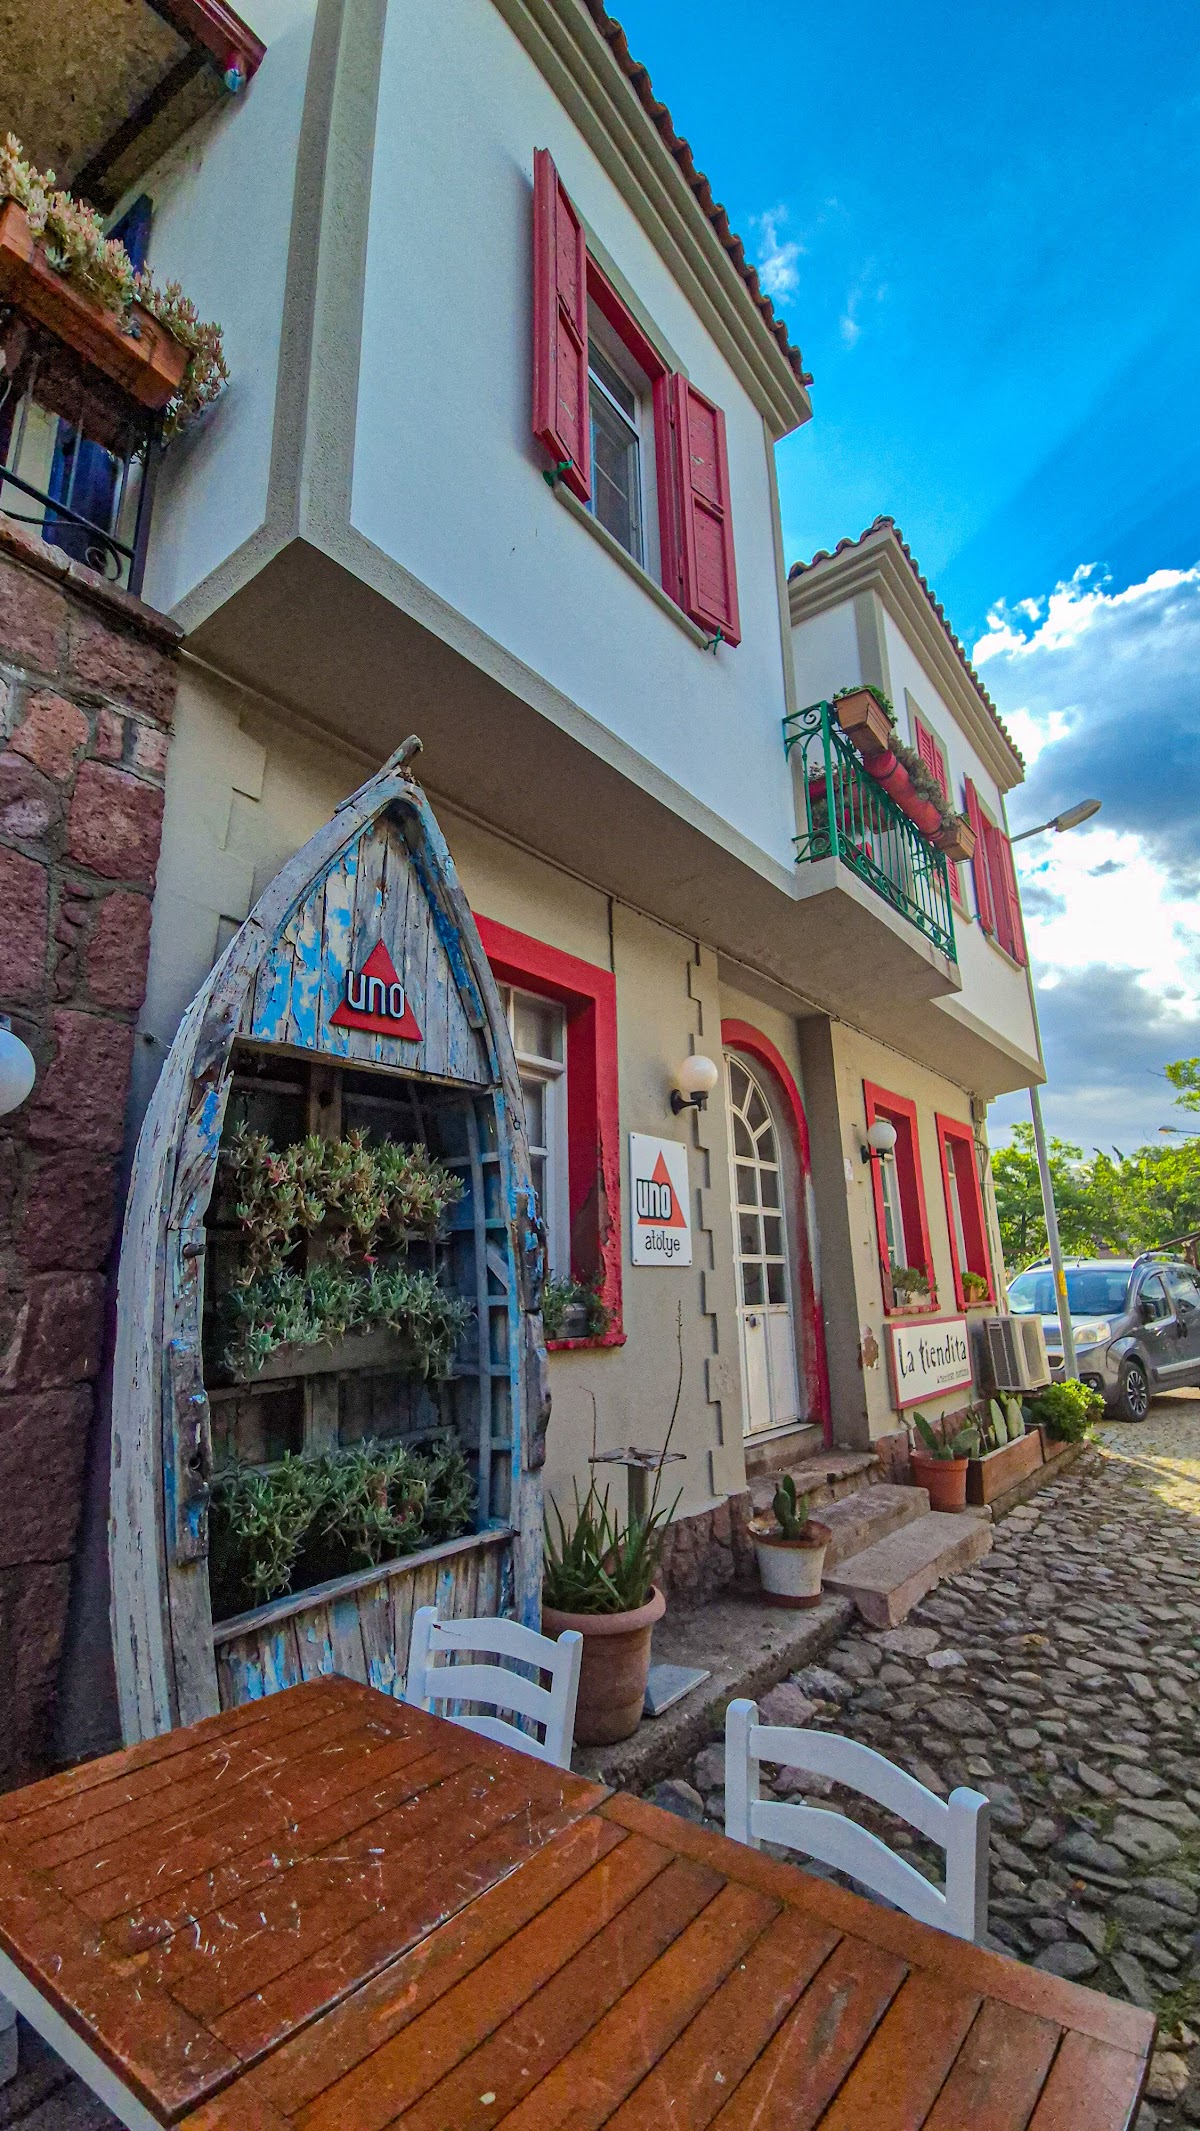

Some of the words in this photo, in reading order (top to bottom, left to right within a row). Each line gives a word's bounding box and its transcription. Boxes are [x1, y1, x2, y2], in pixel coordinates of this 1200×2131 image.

[345, 969, 405, 1019] uno
[636, 1178, 672, 1221] uno
[645, 1229, 681, 1258] atölye
[919, 1334, 967, 1374] tiendita
